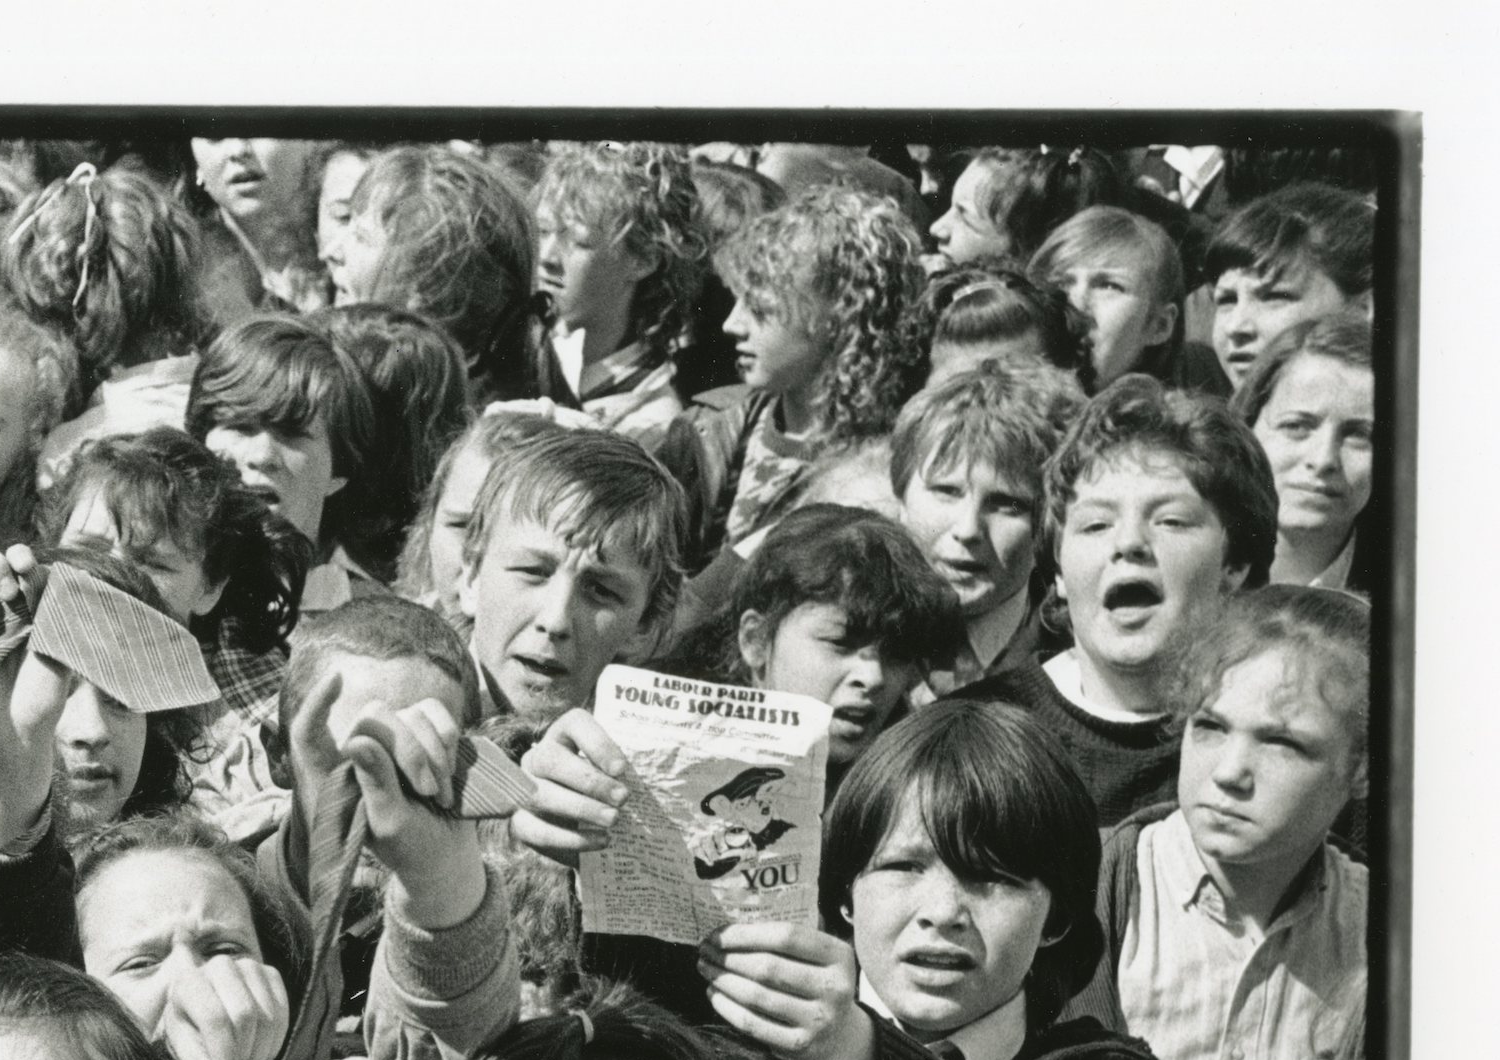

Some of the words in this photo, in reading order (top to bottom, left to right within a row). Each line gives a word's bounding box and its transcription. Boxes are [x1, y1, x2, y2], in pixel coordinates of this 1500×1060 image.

[653, 677, 713, 697] LABOUR
[717, 687, 767, 703] PARTY
[614, 684, 680, 710] YOUNG
[688, 699, 801, 726] SOCIALISTS
[741, 862, 800, 891] YOU
